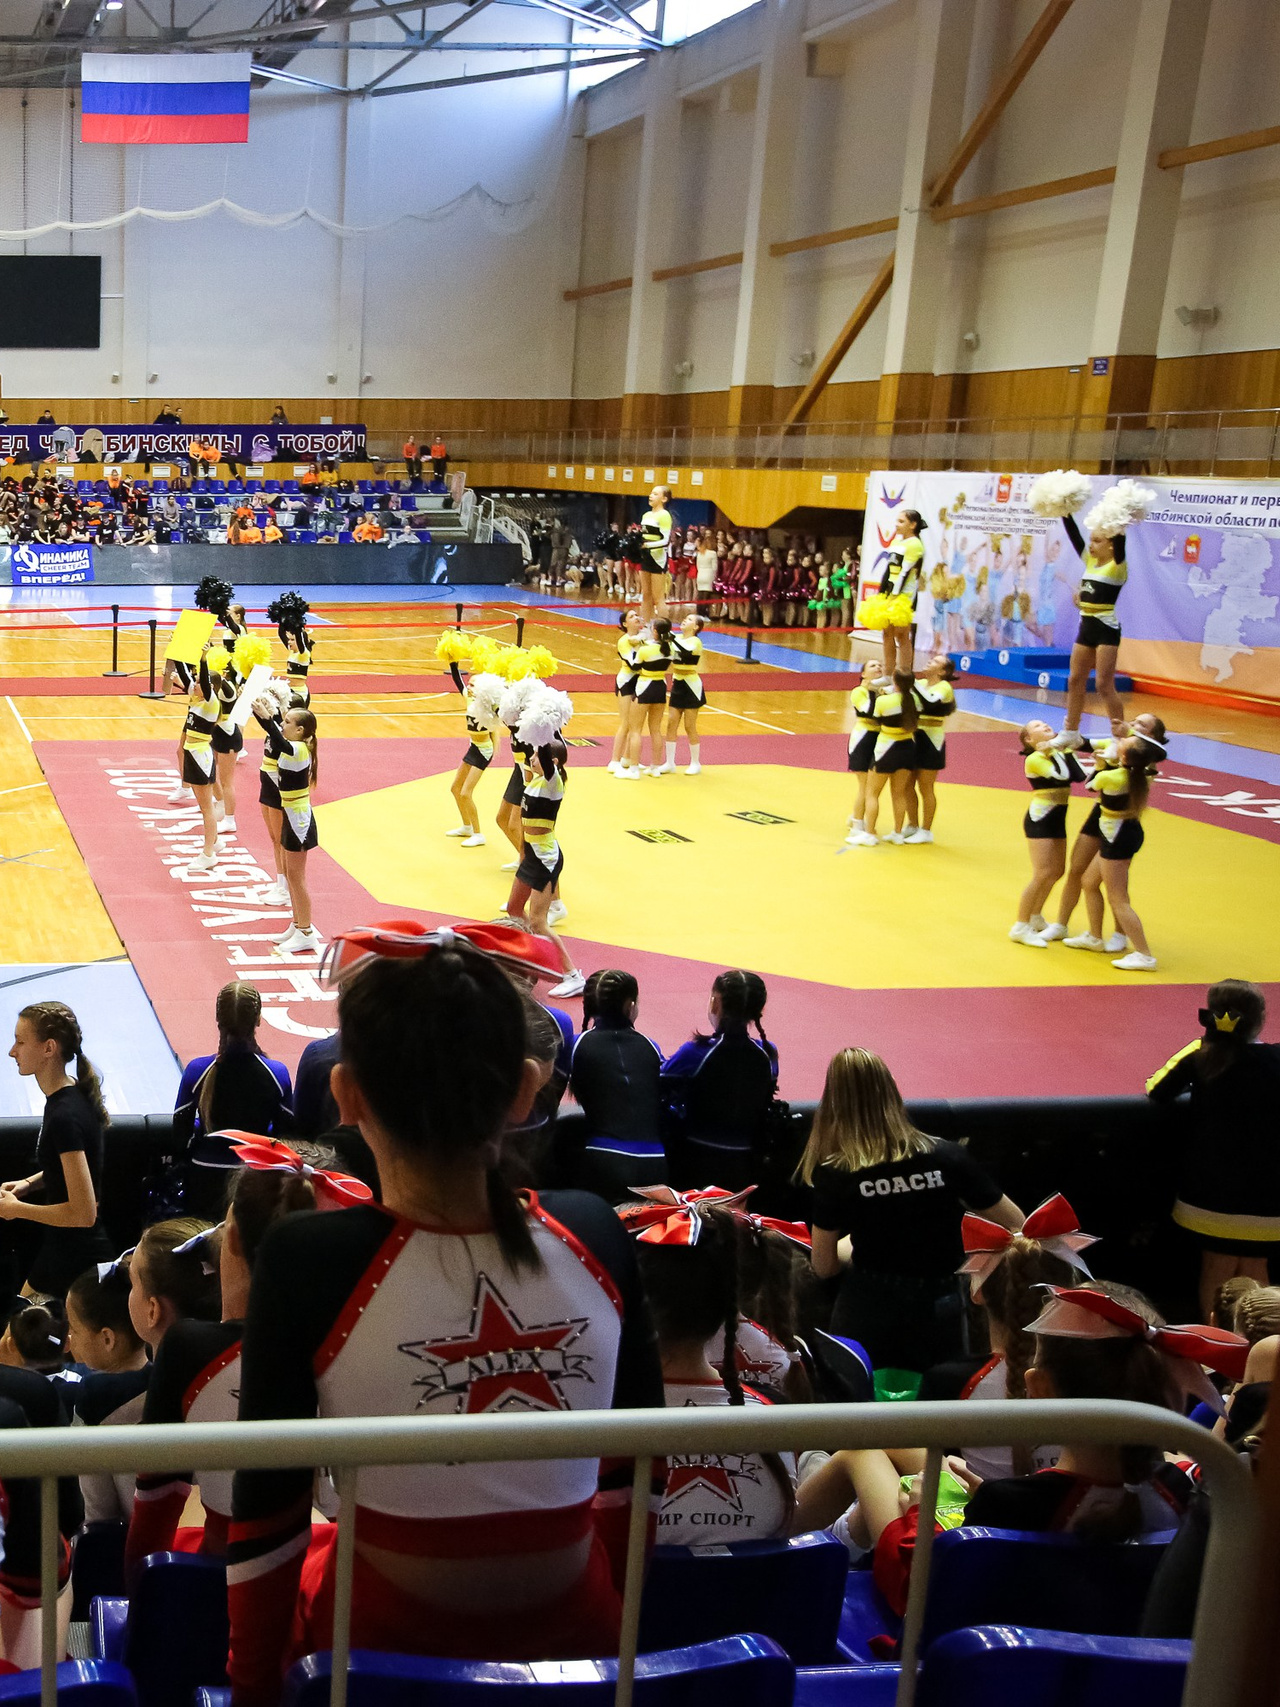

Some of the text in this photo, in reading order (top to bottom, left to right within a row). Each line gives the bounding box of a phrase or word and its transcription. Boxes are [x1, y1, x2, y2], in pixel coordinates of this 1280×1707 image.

[39, 433, 193, 454] ЧЛБИНСК!
[1169, 489, 1239, 505] Чемпионат
[1239, 495, 1249, 507] и
[1215, 512, 1267, 528] области
[42, 562, 88, 572] CHEER TEAM
[20, 572, 86, 584] ВПЕРЁД!
[859, 1170, 946, 1197] COACH
[467, 1351, 545, 1377] ALEX
[690, 1512, 755, 1527] СПОРТ
